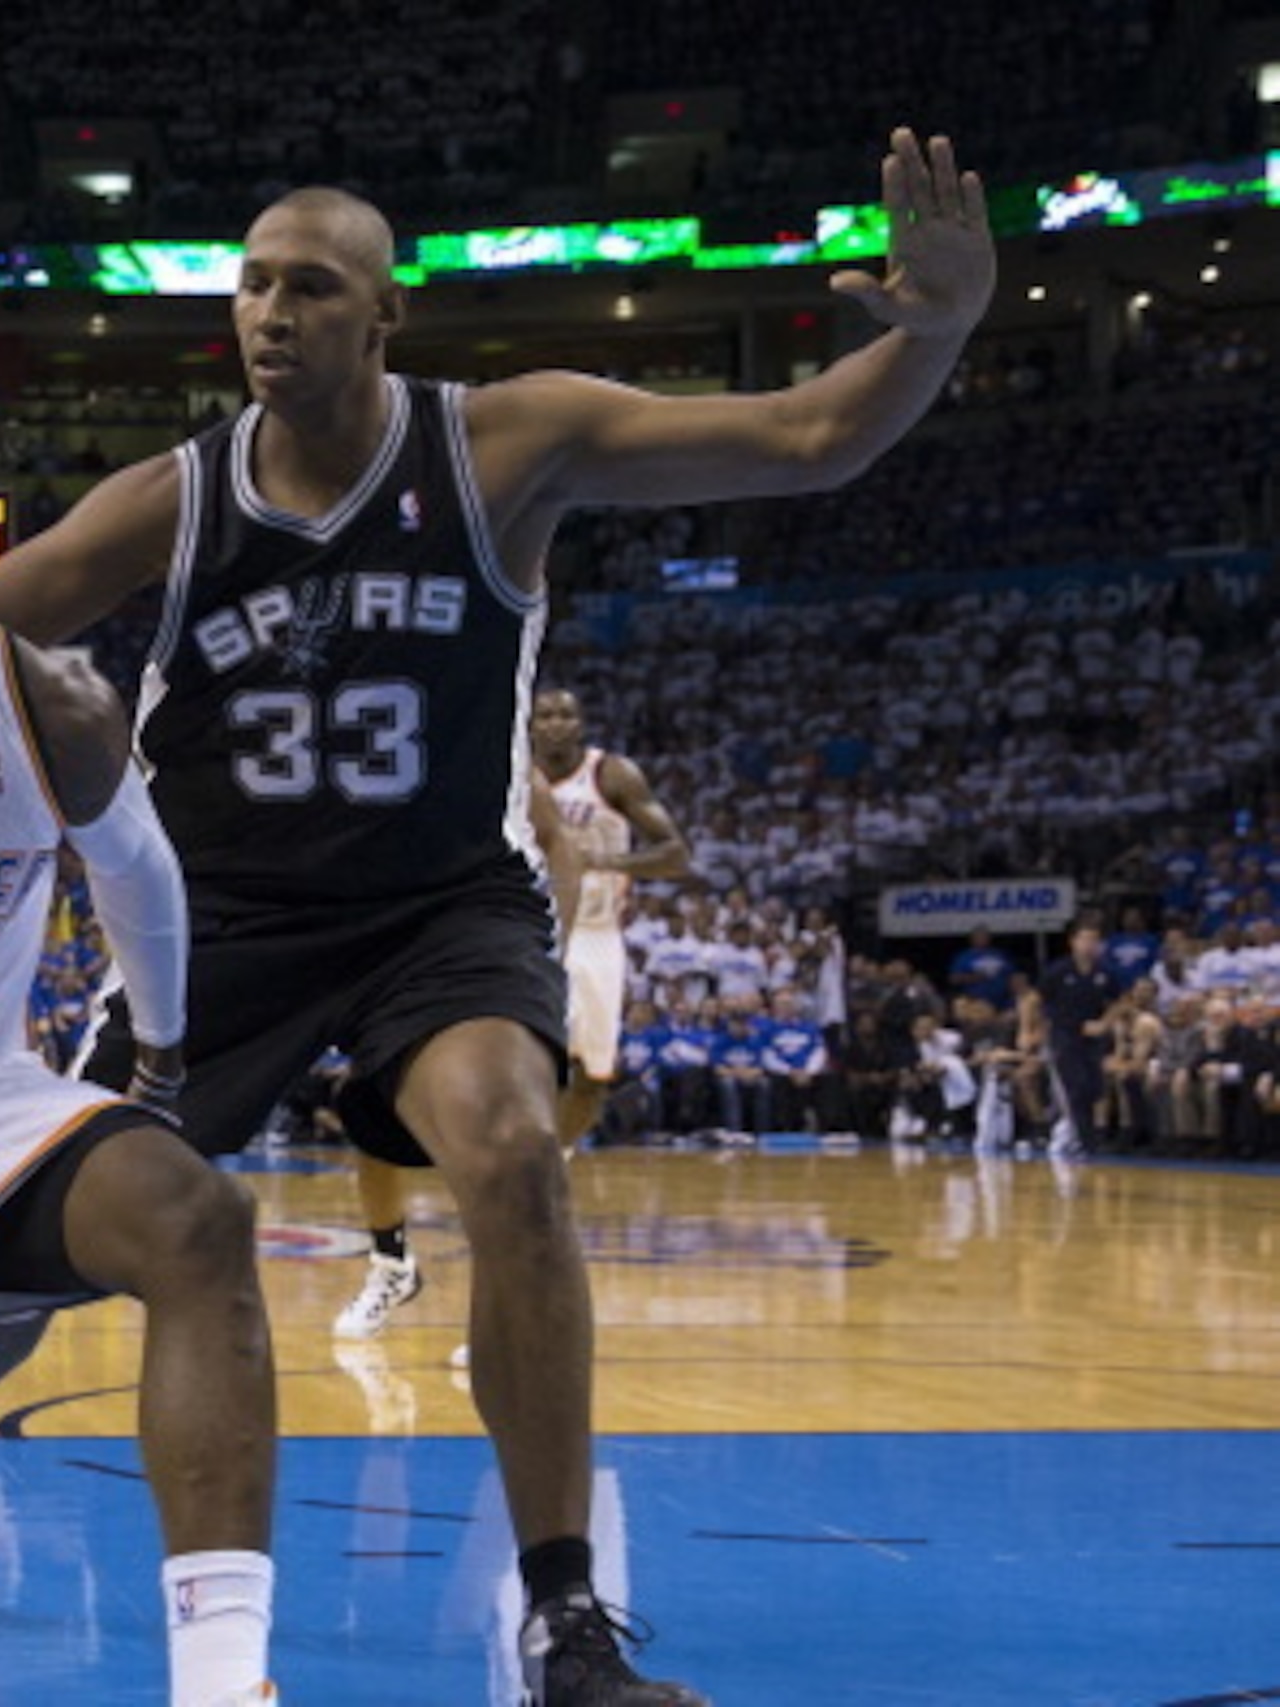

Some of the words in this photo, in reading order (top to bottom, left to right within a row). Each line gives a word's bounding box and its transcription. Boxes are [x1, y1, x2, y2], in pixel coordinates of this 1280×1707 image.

[192, 570, 468, 676] SPURS
[224, 677, 427, 804] 33
[892, 887, 1059, 915] HOMELAND
